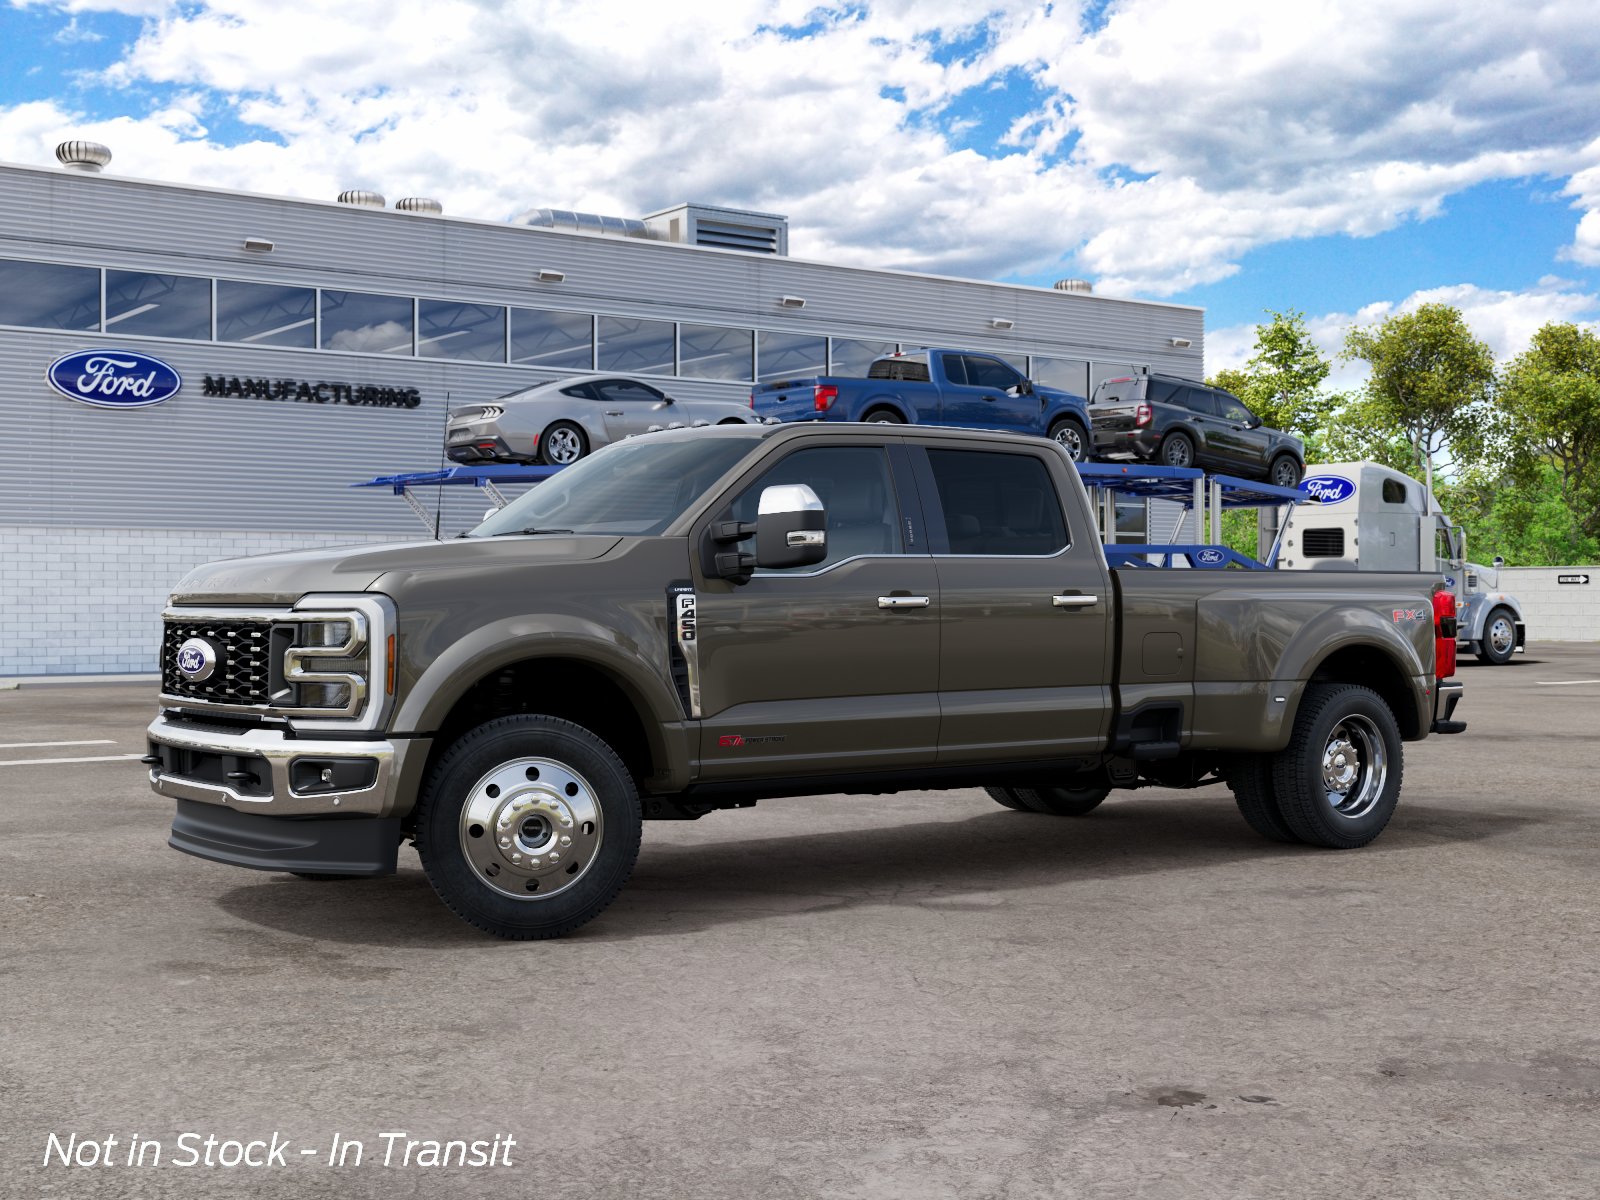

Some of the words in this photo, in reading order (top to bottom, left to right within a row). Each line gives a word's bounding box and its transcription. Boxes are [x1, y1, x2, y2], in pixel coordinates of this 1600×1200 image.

[77, 357, 157, 398] Ford
[202, 374, 421, 409] MANUFACTURING
[1306, 480, 1343, 500] Ford
[1201, 550, 1220, 562] Ford
[1392, 609, 1426, 622] FX4
[181, 649, 201, 670] Ford
